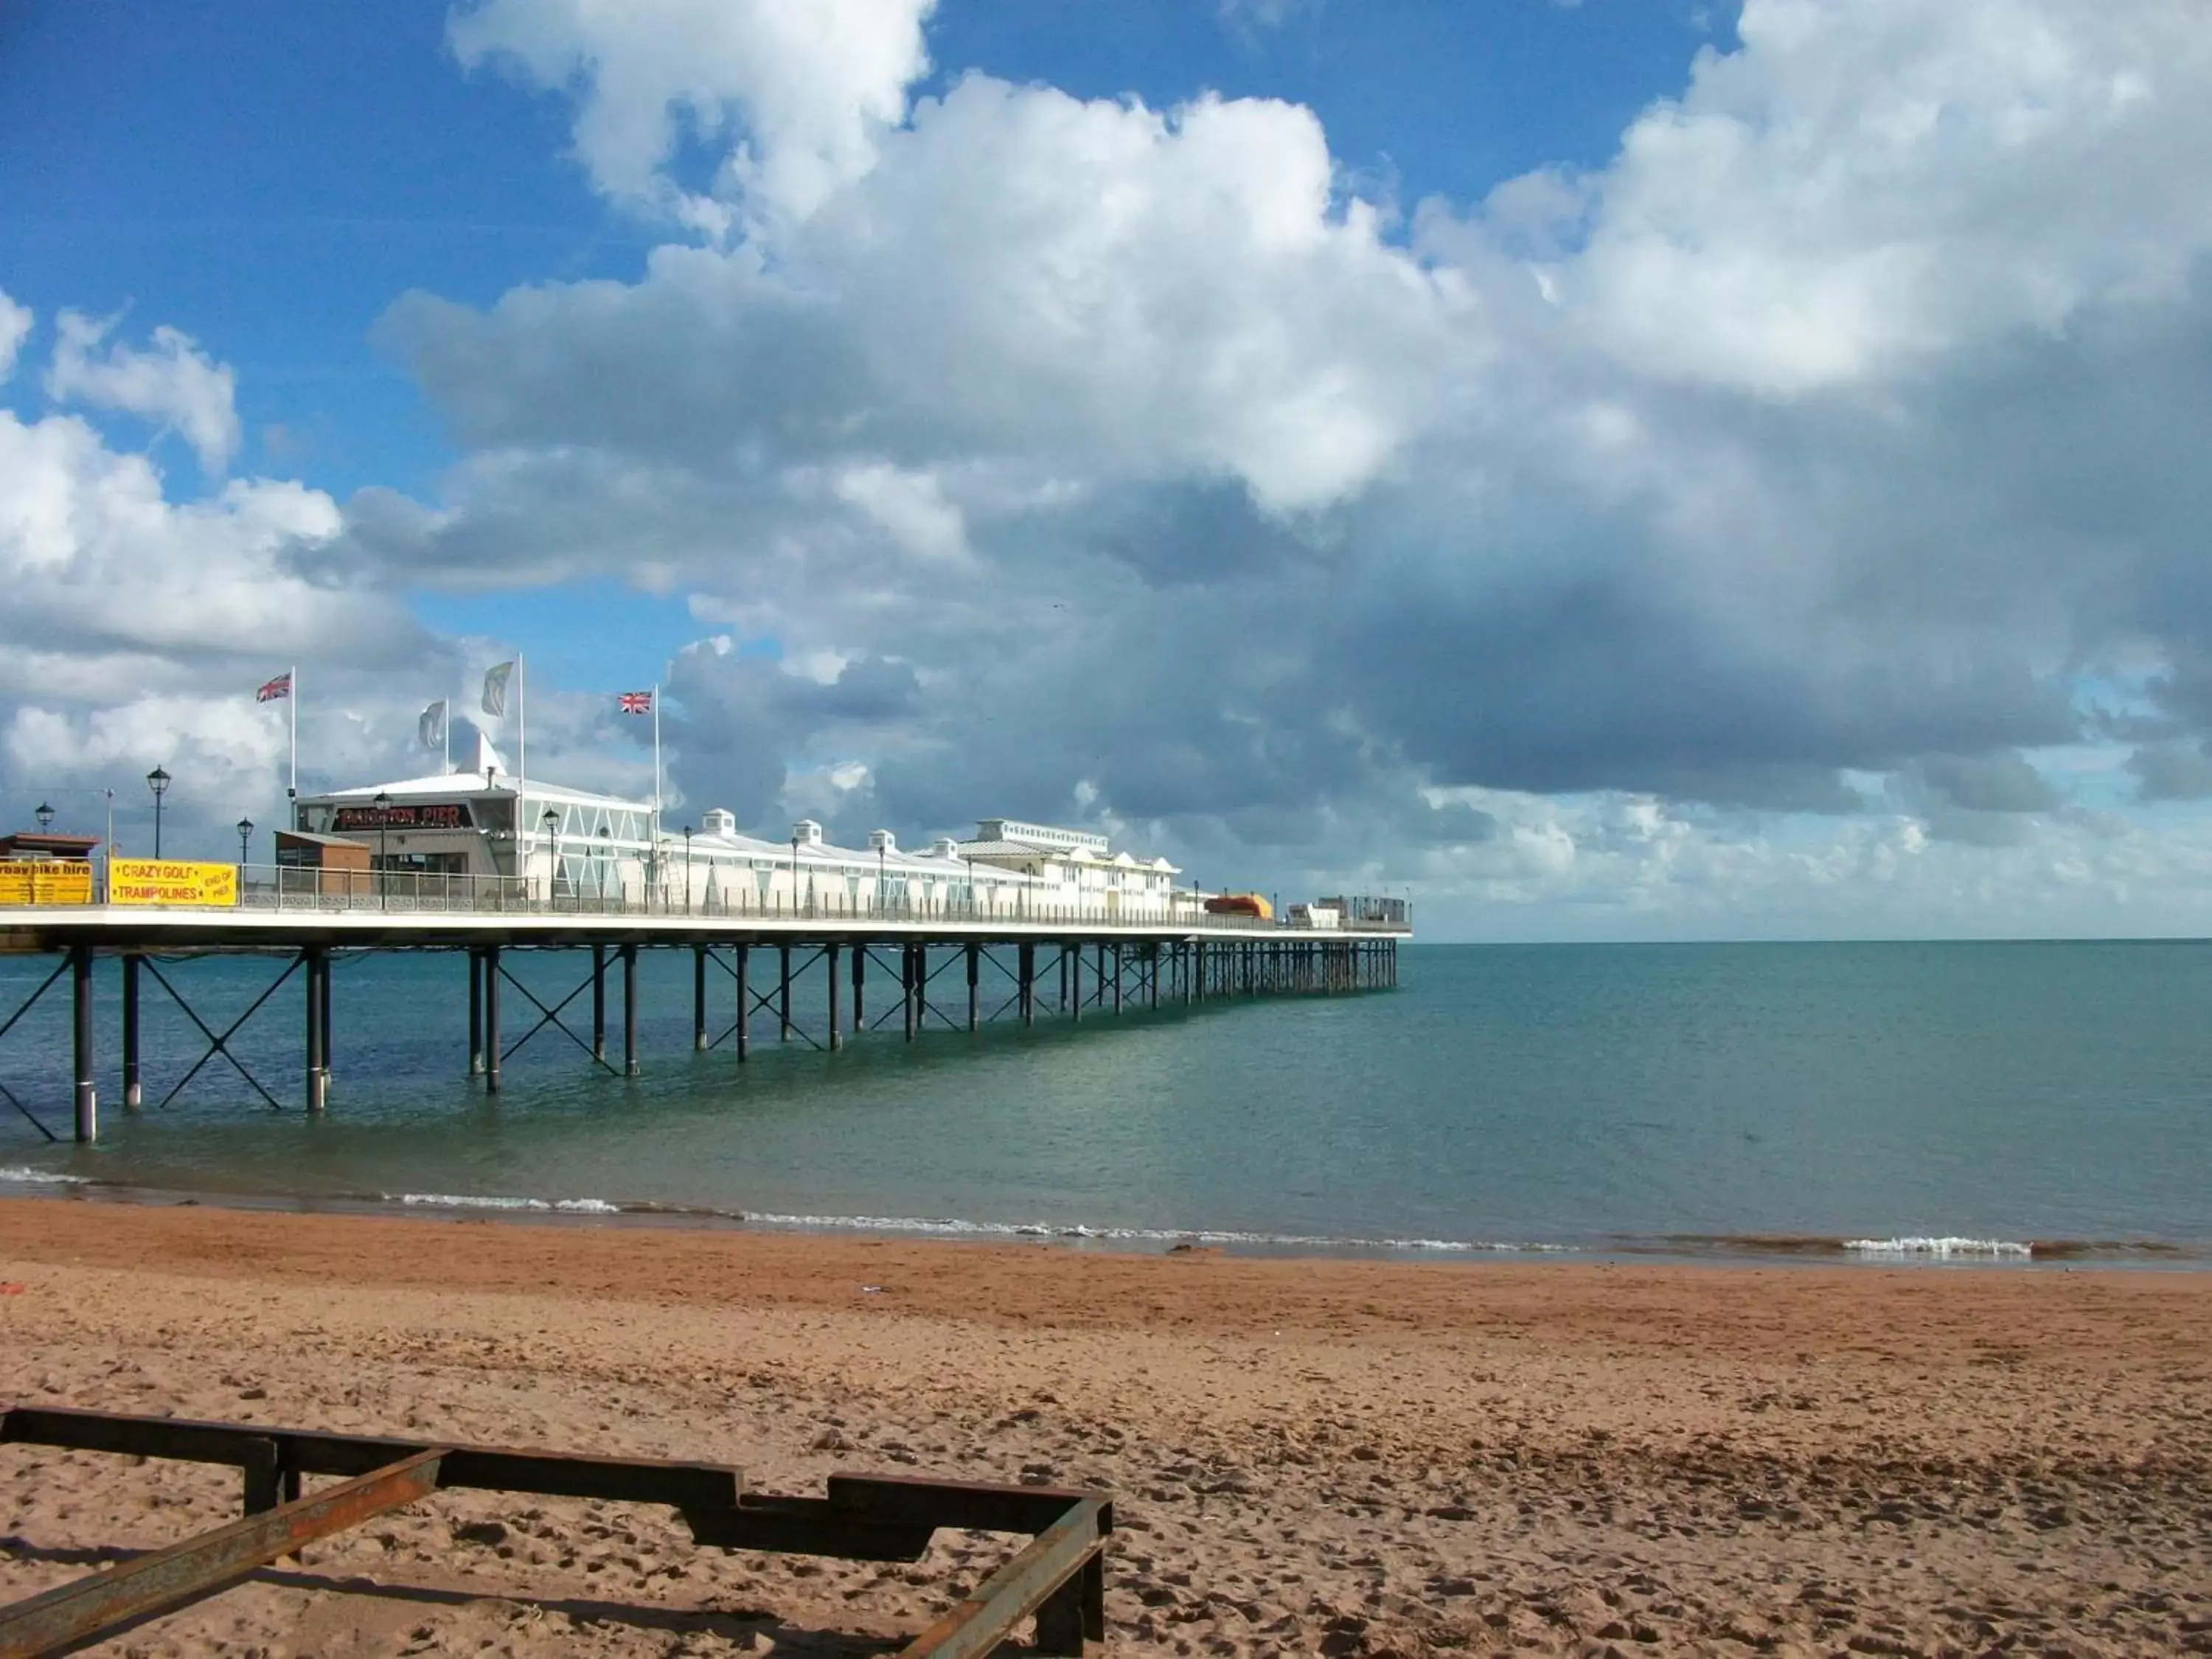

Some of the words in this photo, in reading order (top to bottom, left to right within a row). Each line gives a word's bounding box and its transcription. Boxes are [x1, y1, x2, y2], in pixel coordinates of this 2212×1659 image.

[423, 807, 459, 825] PIER
[32, 863, 60, 874] bike
[63, 863, 90, 874] hire
[122, 863, 161, 877] CRAZY
[163, 866, 193, 879] GOLF
[118, 886, 196, 900] TRAMPOLINES
